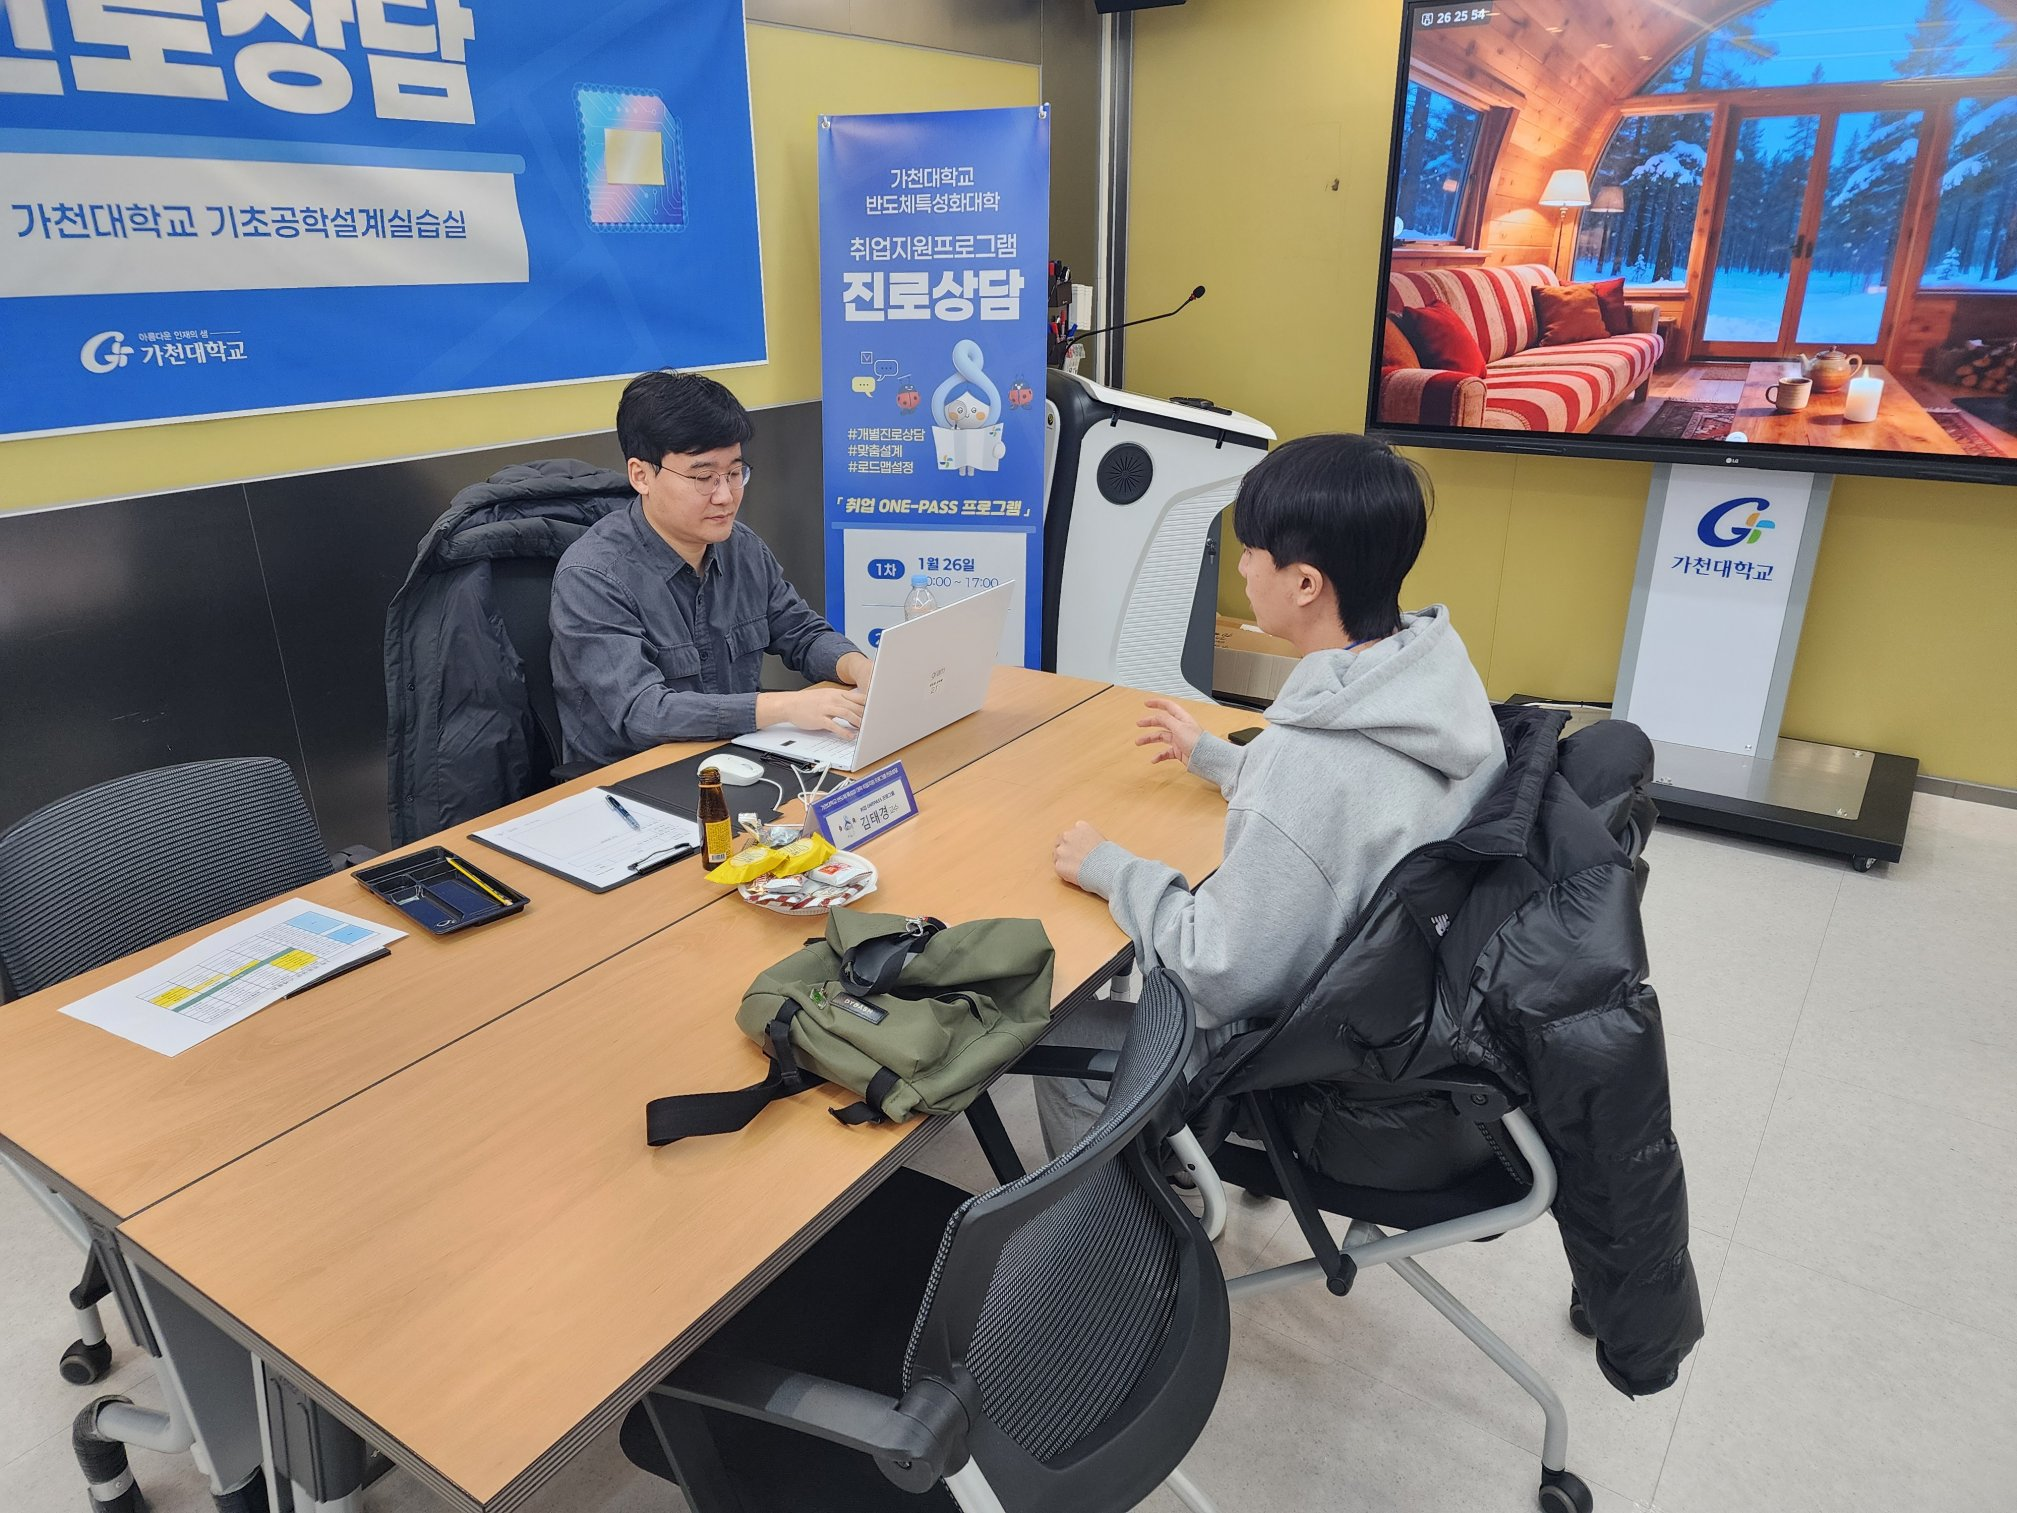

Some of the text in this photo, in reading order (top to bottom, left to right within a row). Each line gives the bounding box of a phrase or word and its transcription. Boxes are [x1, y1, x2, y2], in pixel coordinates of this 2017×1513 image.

[1437, 12, 1451, 24] 26
[1454, 10, 1468, 22] 25
[0, 0, 477, 124] 로상담
[890, 166, 975, 189] 가천대학교
[866, 191, 1001, 215] 반도체특성화대학
[12, 203, 468, 240] 가천대학교 기초공학설계실습실
[850, 233, 1017, 261] 취업지원프로그램
[842, 269, 1025, 322] 진로상담
[138, 329, 209, 342] 아름다운 인재의 샘
[140, 341, 248, 367] 가천대학교
[847, 428, 926, 442] #개별진로상담
[847, 444, 903, 458] #맞춤설계
[847, 461, 914, 474] #로드맵설정
[878, 499, 959, 514] ONE-PASS
[875, 563, 897, 577] 1차
[918, 557, 975, 572] 1월 26일
[1671, 556, 1774, 581] 가천대학교
[927, 576, 952, 588] 0:00
[965, 577, 999, 588] 17:00
[860, 806, 889, 831] 김태경
